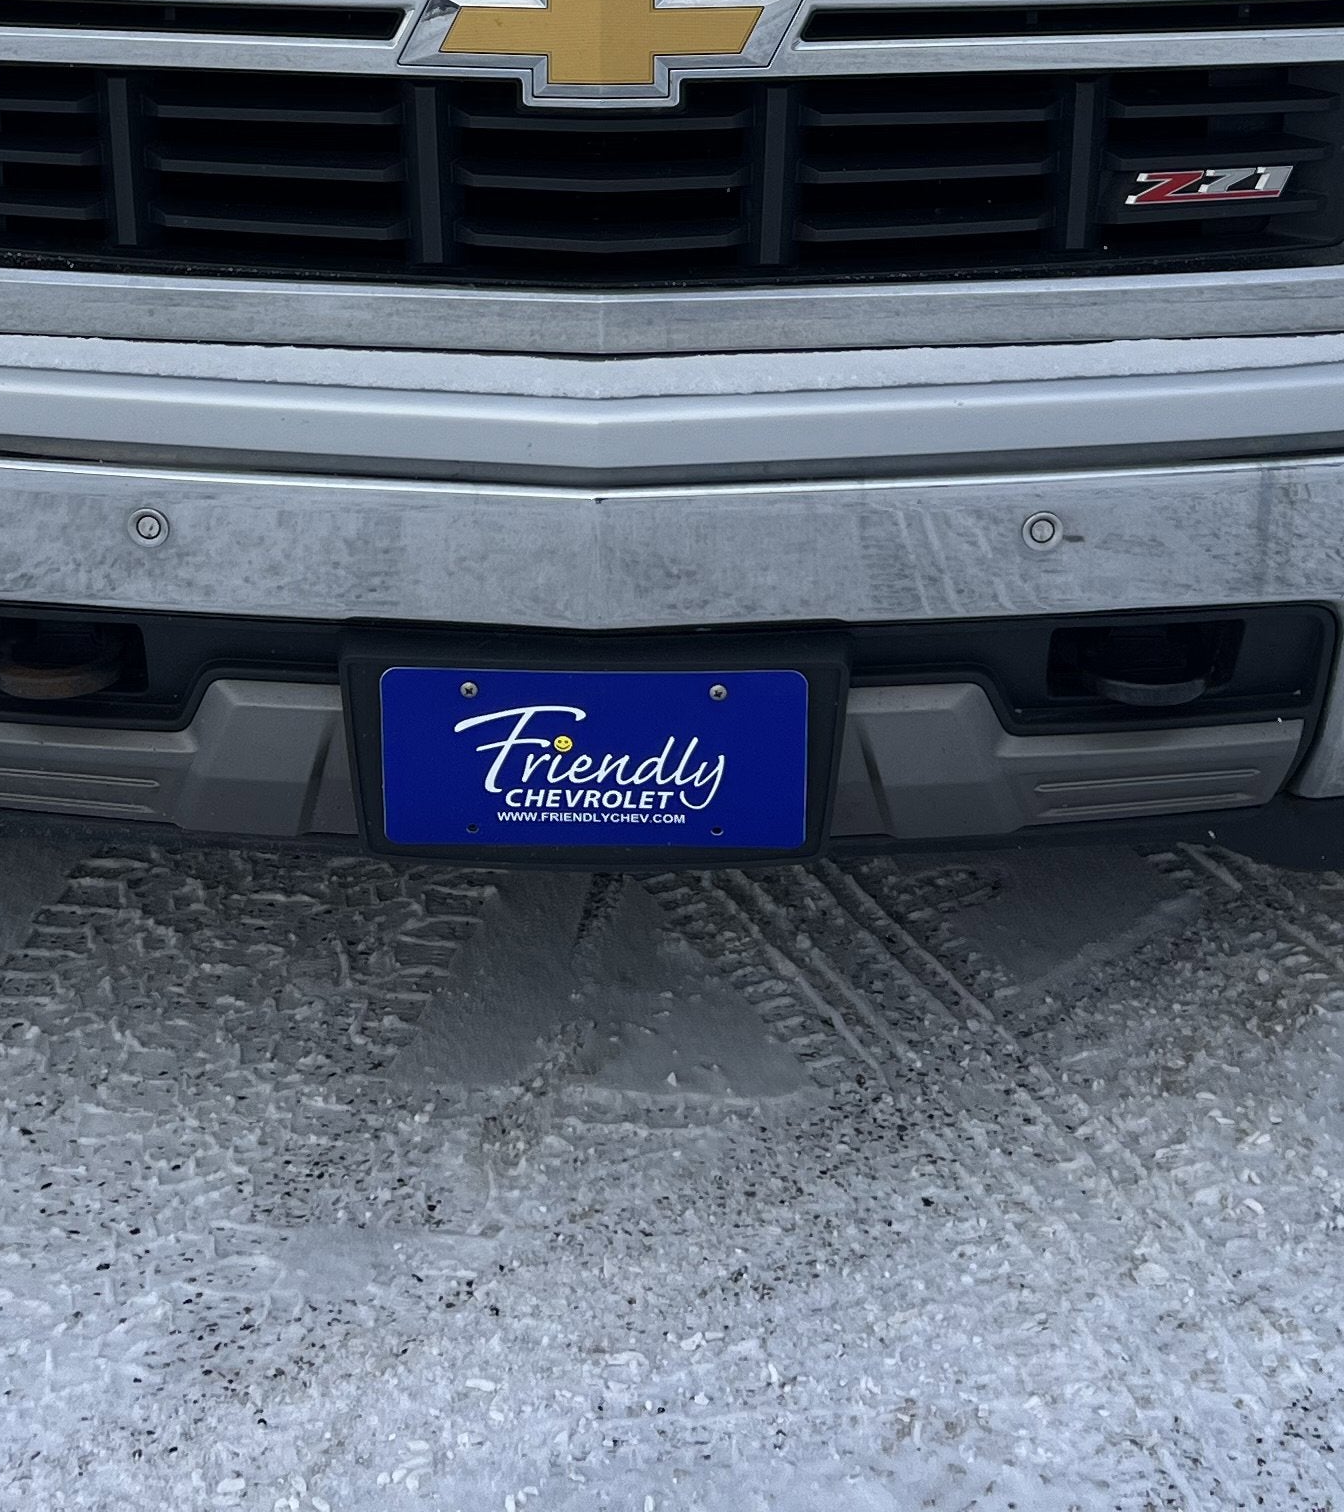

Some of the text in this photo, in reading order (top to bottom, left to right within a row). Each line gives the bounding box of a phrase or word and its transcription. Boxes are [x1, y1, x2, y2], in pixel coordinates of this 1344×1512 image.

[1124, 165, 1295, 205] Z71
[454, 705, 726, 810] Friendly
[505, 788, 674, 810] CHEVROLET
[497, 810, 686, 825] WWW.FRIENDLYCHEV.COM
